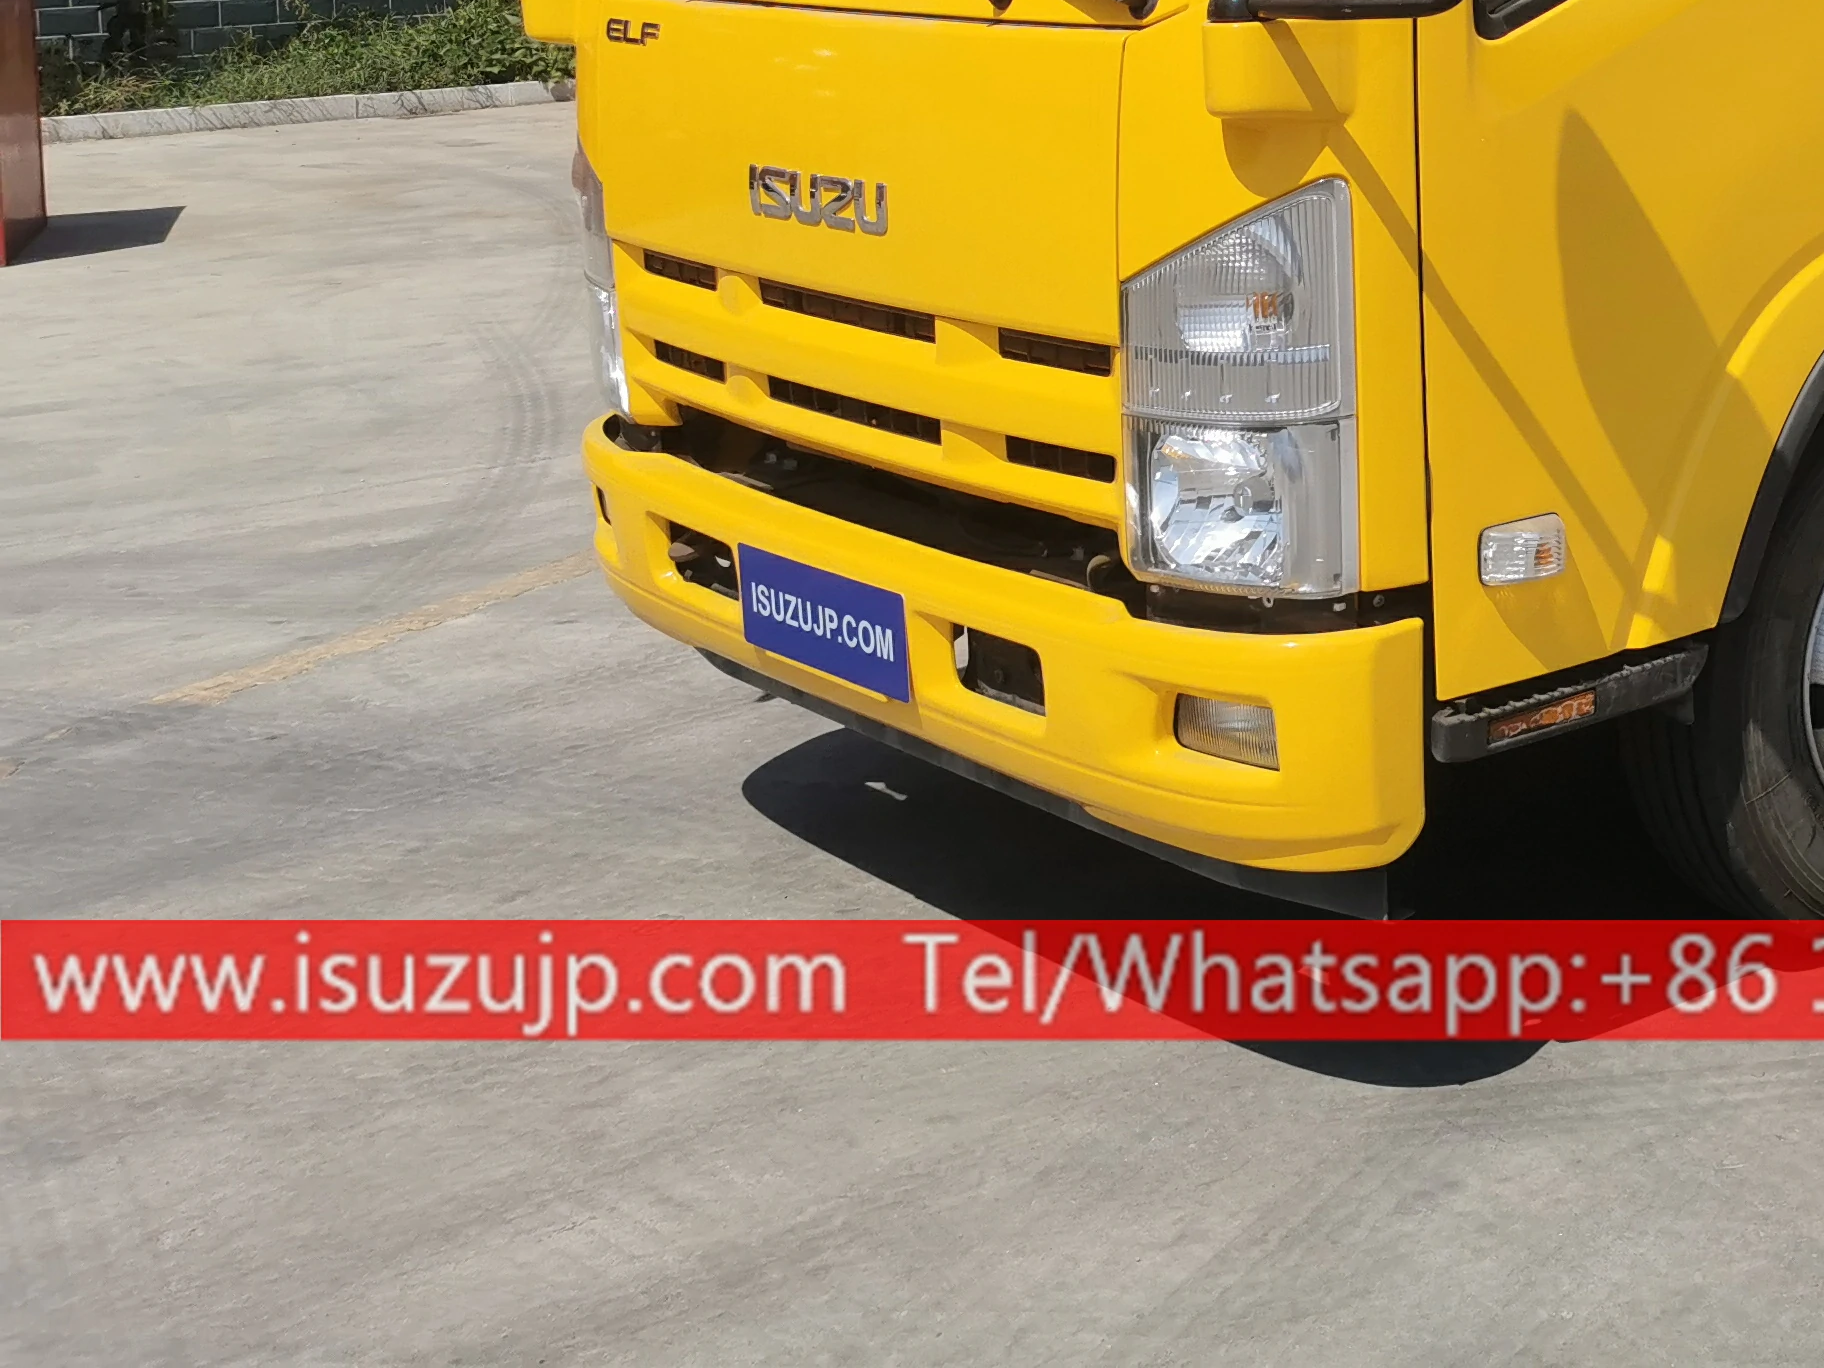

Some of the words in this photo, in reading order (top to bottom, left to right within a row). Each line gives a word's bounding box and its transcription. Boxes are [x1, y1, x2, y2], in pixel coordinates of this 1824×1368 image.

[606, 17, 661, 47] ELF
[749, 163, 889, 237] ISUZU
[750, 581, 895, 663] ISUZUJP.COM
